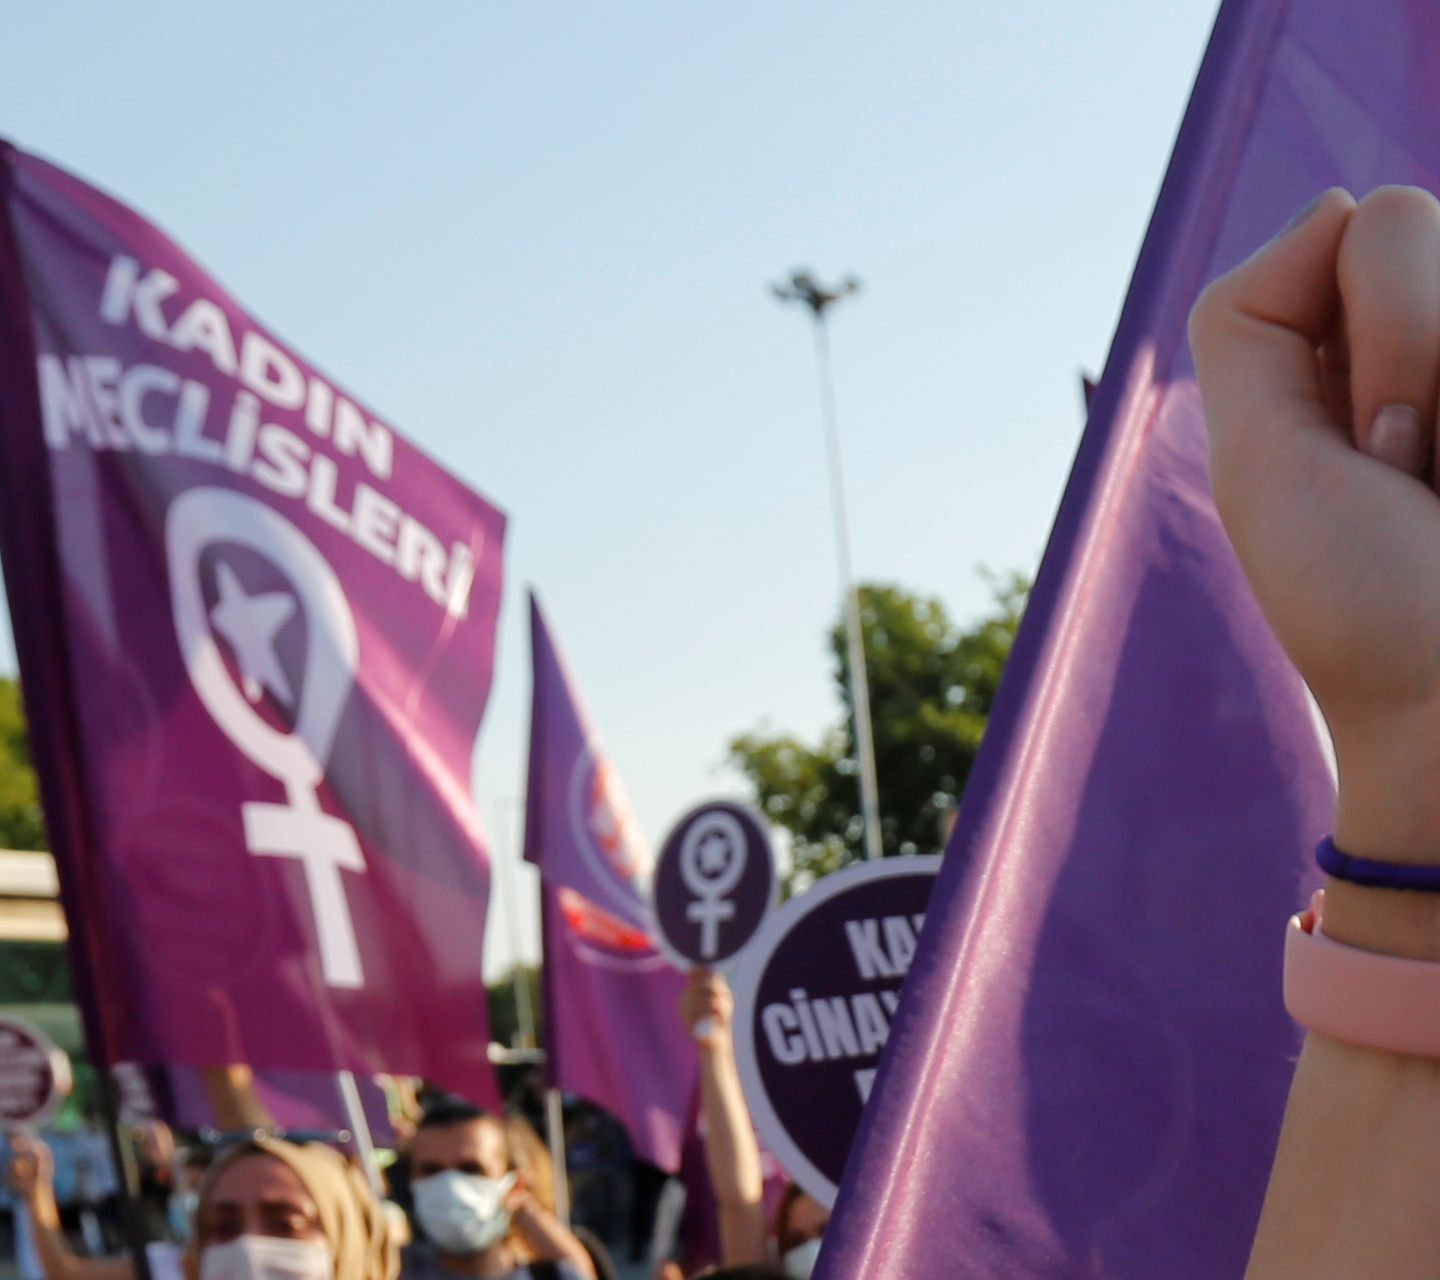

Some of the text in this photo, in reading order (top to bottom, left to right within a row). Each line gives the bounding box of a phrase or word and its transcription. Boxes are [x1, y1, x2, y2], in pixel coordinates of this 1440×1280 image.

[101, 254, 394, 480] KADIN
[38, 353, 476, 620] MECLİSLERİ
[844, 912, 927, 980] KA
[762, 986, 900, 1067] CİNA
